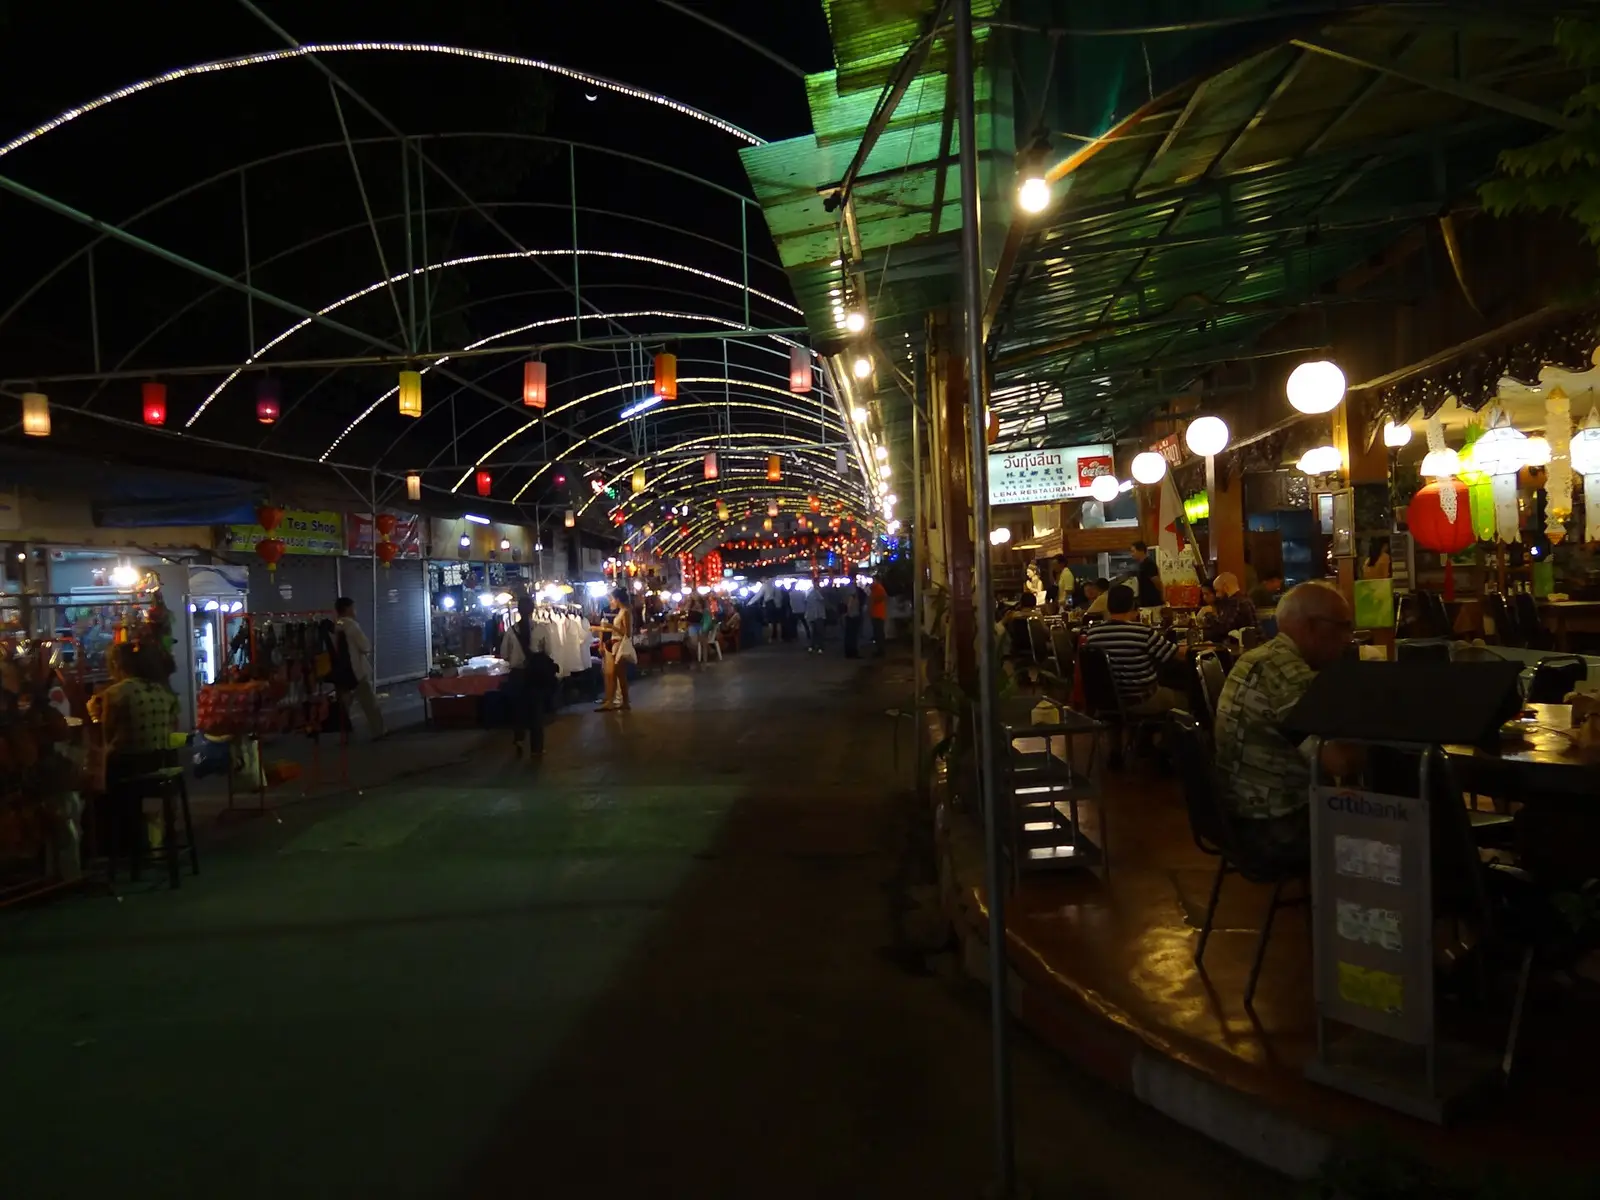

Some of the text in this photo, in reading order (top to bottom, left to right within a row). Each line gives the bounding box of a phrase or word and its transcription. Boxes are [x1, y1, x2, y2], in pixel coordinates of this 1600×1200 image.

[1020, 486, 1077, 496] RESTAURANT
[287, 517, 306, 531] Tea
[311, 519, 336, 534] Shop
[1327, 796, 1409, 821] citibank
